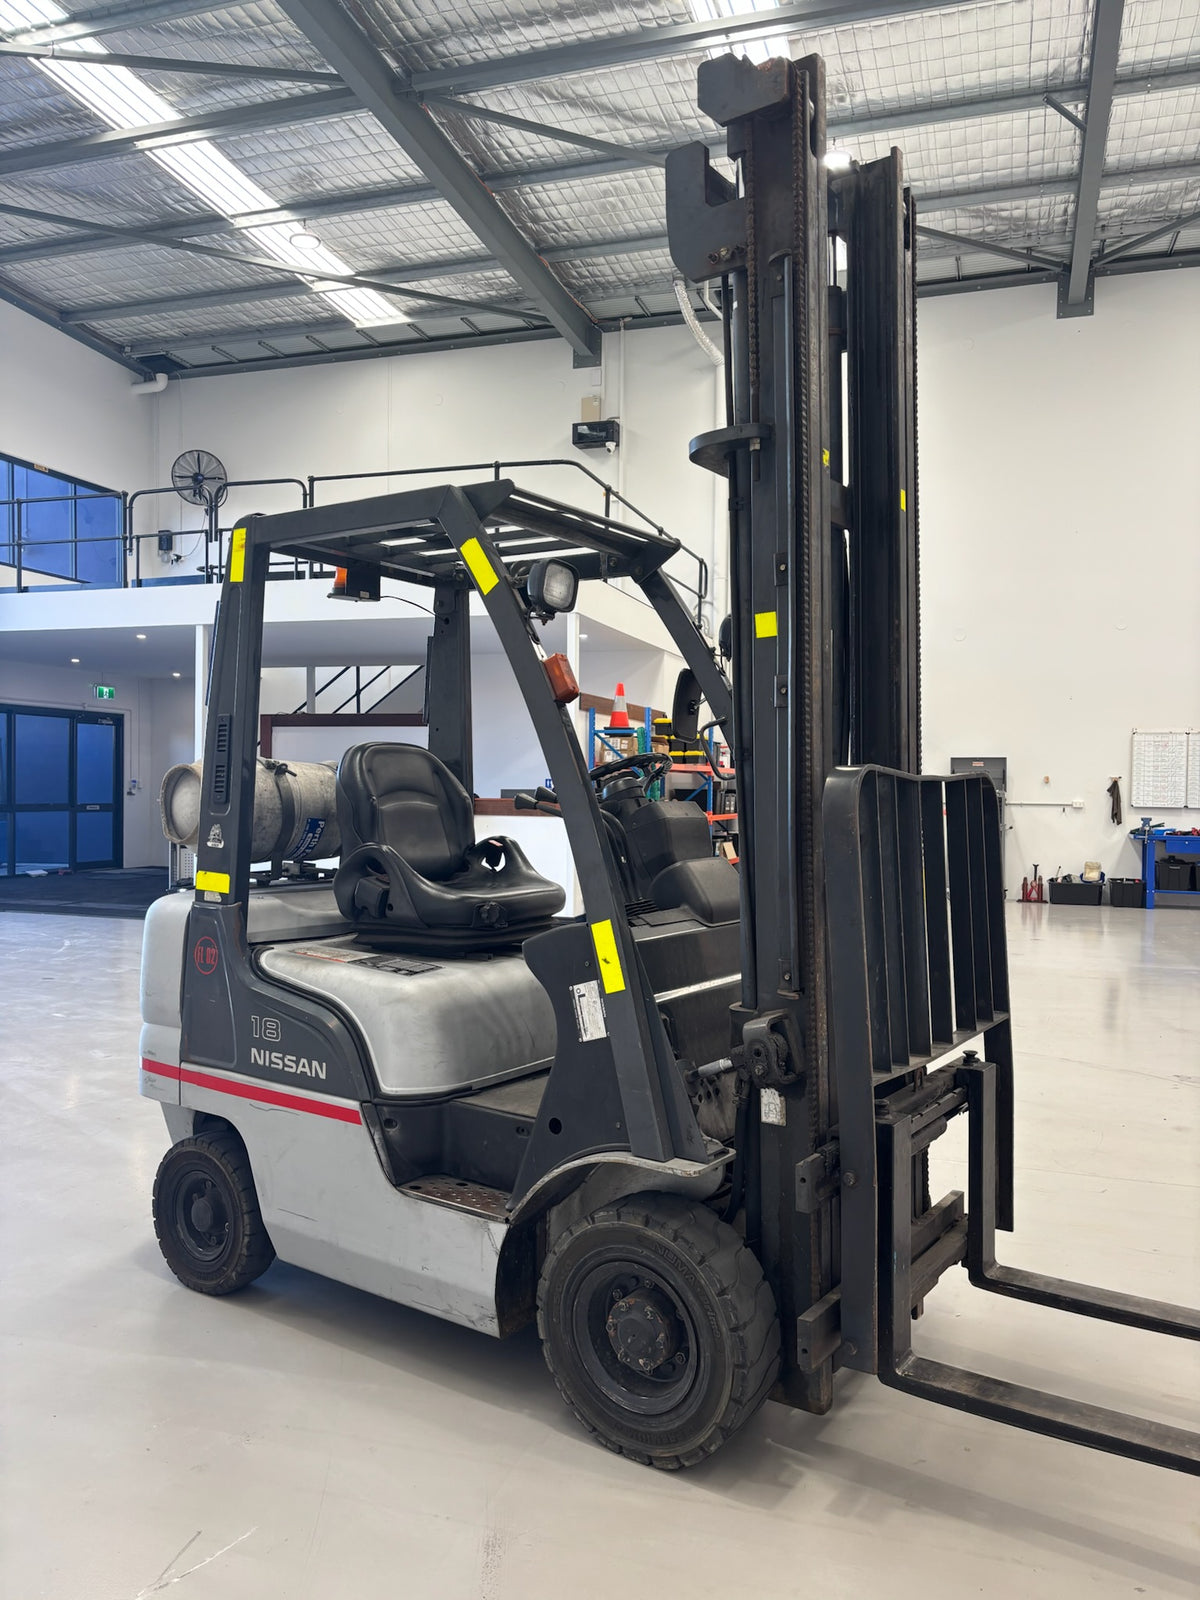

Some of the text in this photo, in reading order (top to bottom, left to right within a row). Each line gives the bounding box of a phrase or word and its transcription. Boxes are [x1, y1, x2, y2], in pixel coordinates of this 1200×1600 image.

[308, 820, 326, 848] Perth
[251, 1015, 281, 1042] 18
[250, 1047, 327, 1080] NISSAN
